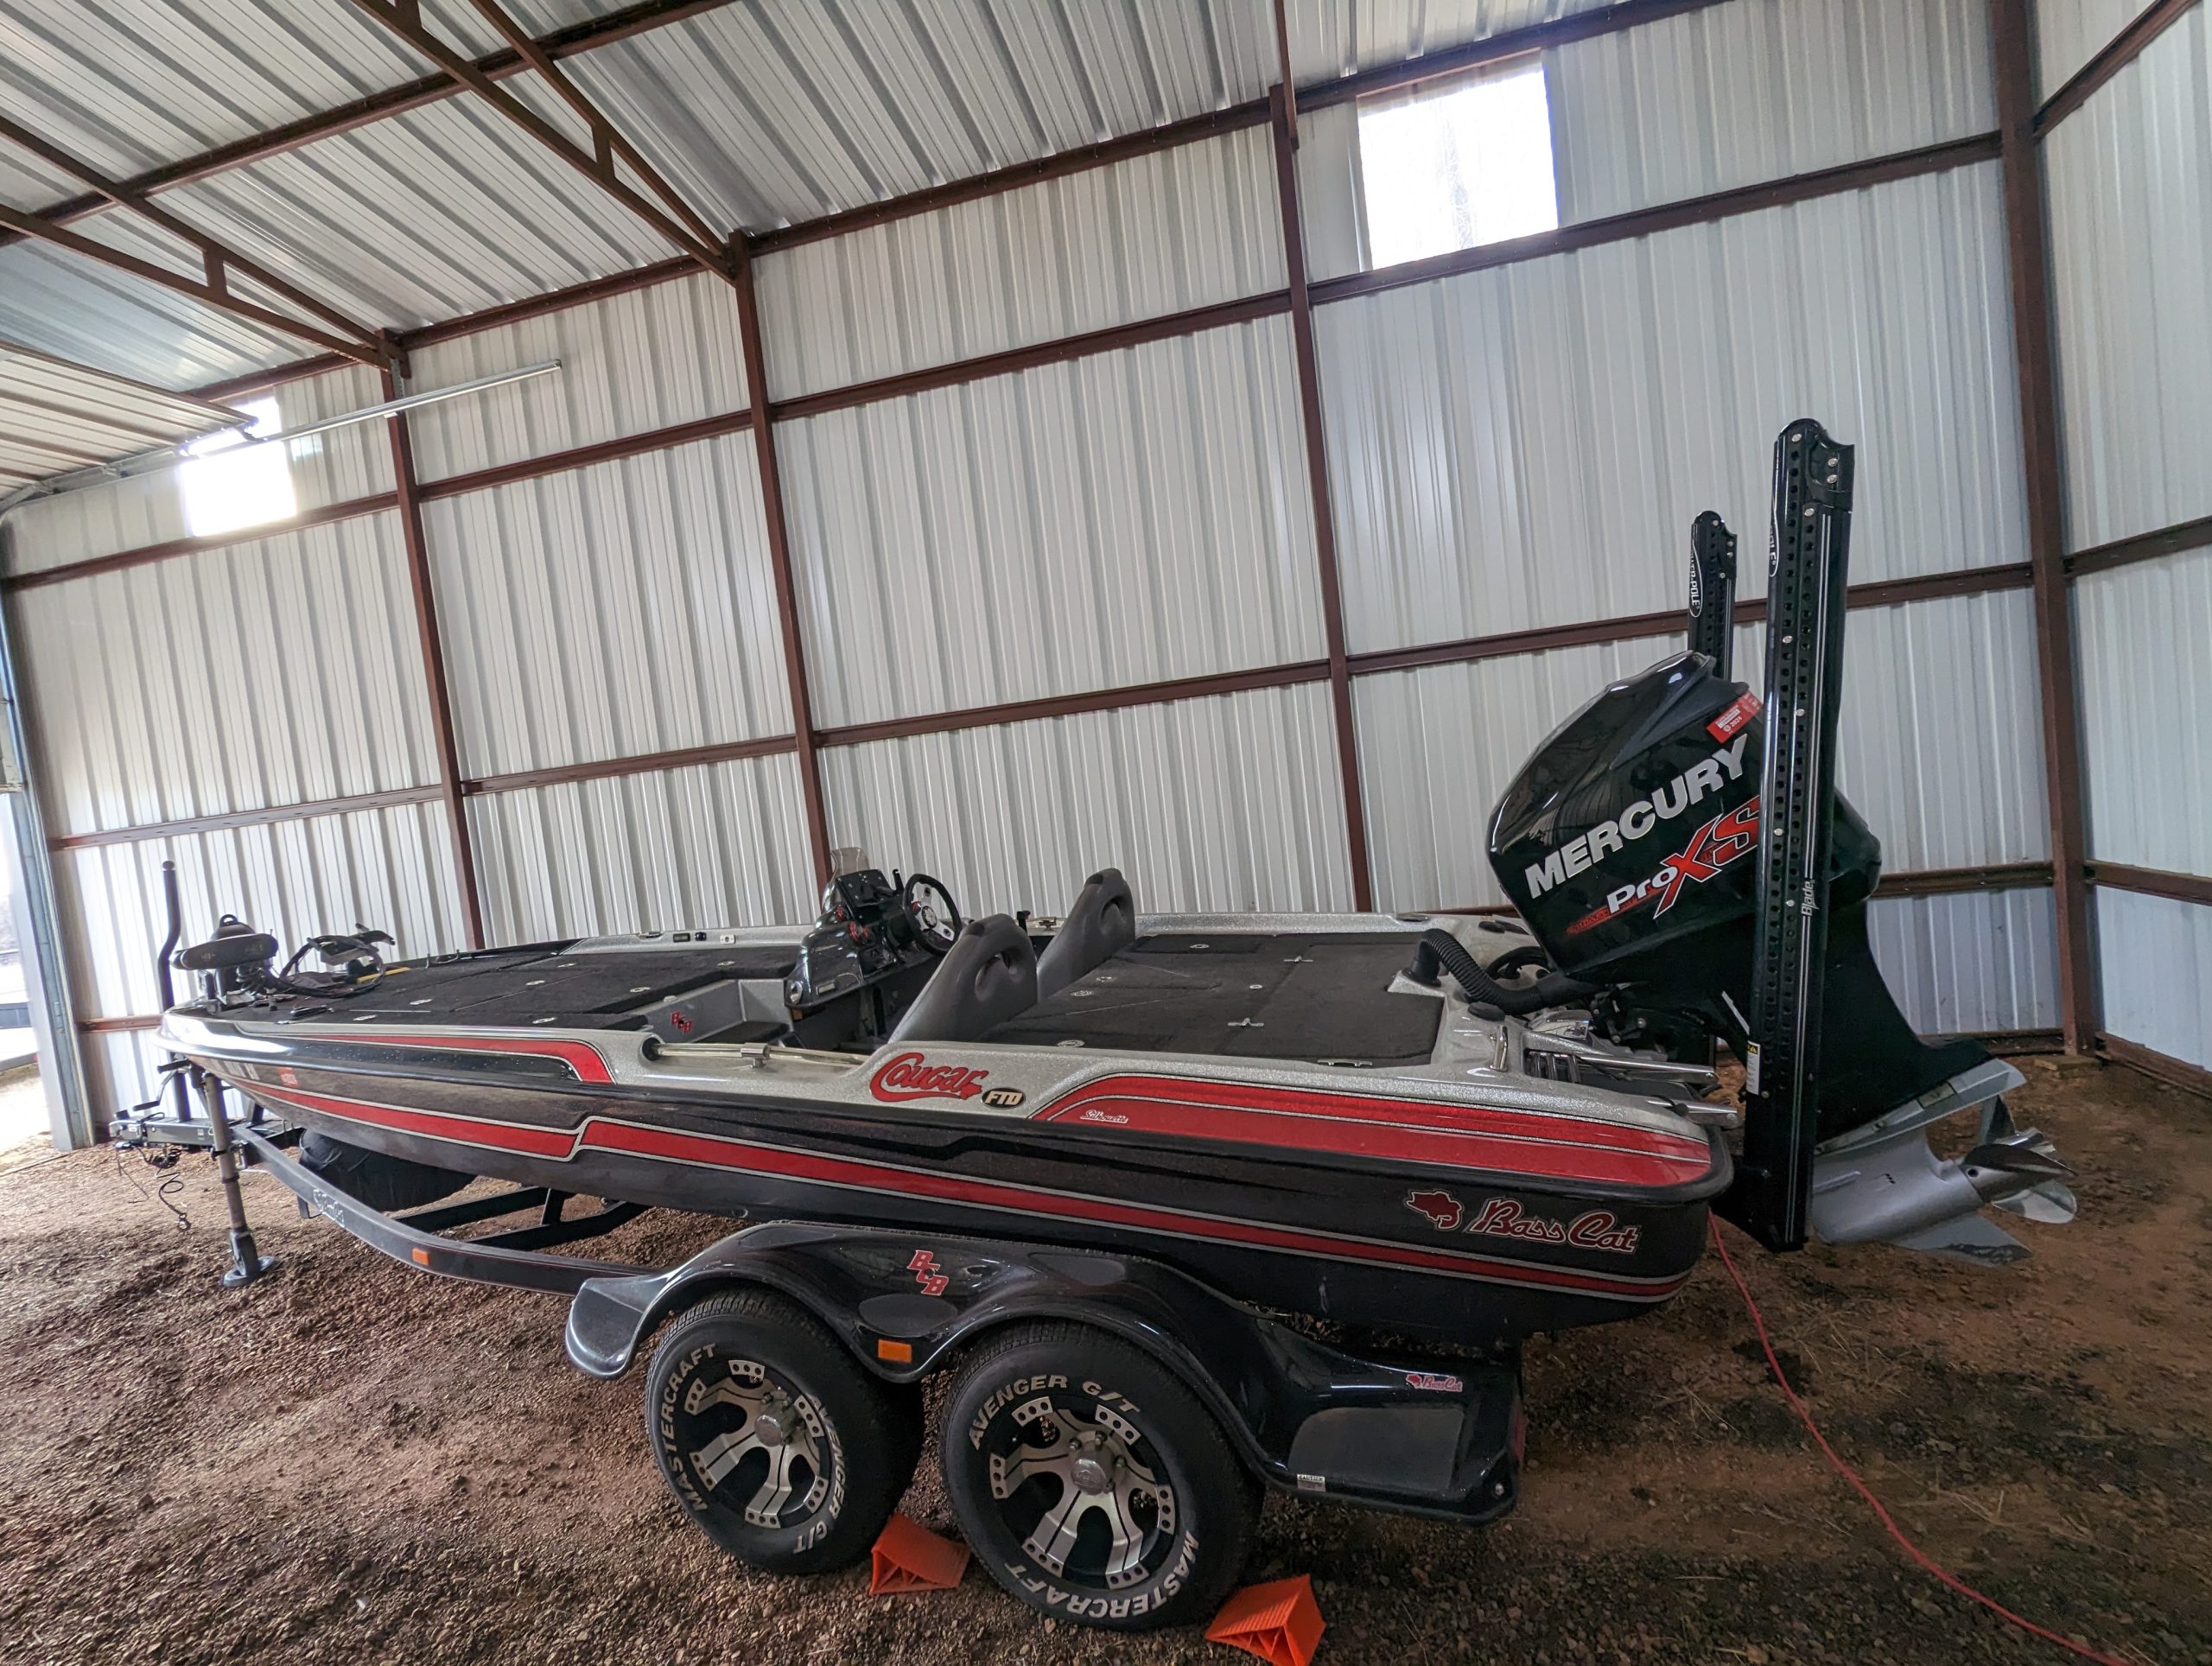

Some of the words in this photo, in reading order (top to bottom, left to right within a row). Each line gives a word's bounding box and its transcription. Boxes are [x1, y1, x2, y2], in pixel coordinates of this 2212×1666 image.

[1524, 734, 1747, 900] MERCURY
[1802, 881, 1820, 916] Blade
[869, 1052, 989, 1103] Cougar
[984, 1091, 1021, 1107] FTD
[1468, 1198, 1566, 1243] Bass
[1568, 1211, 1640, 1252] Cat
[661, 1342, 716, 1511] MASTERCRAFT
[969, 1374, 1068, 1451] AVENGER
[1080, 1380, 1141, 1414] G/T
[792, 1522, 830, 1555] G/T
[1004, 1530, 1200, 1619] MASTERCRAFT
